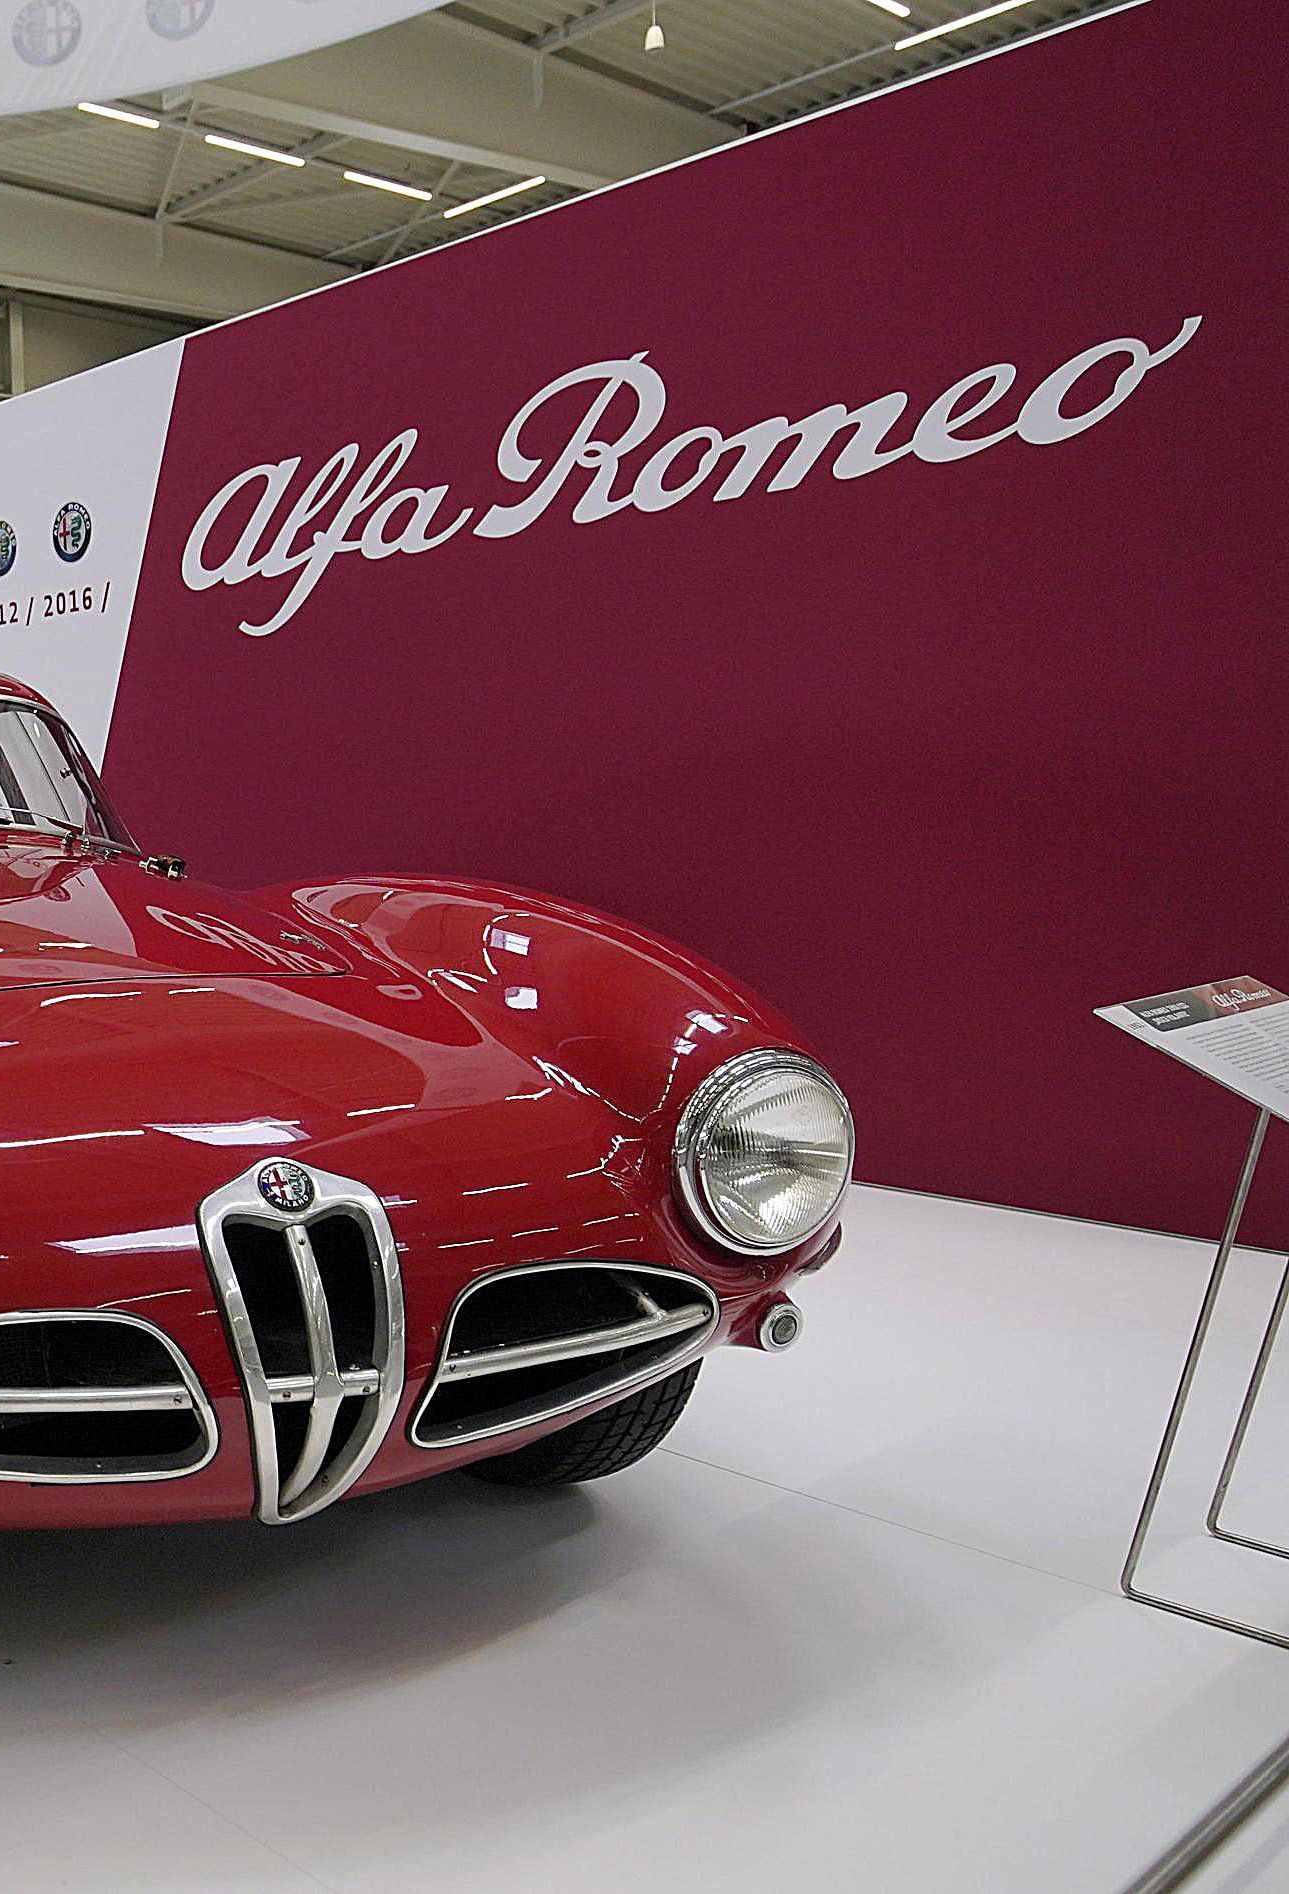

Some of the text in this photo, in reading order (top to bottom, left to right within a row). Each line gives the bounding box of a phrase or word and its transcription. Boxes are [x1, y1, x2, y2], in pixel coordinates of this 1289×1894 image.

[182, 316, 1202, 636] Alfa Romeo
[43, 587, 93, 617] 2016
[275, 1195, 309, 1207] MILANO
